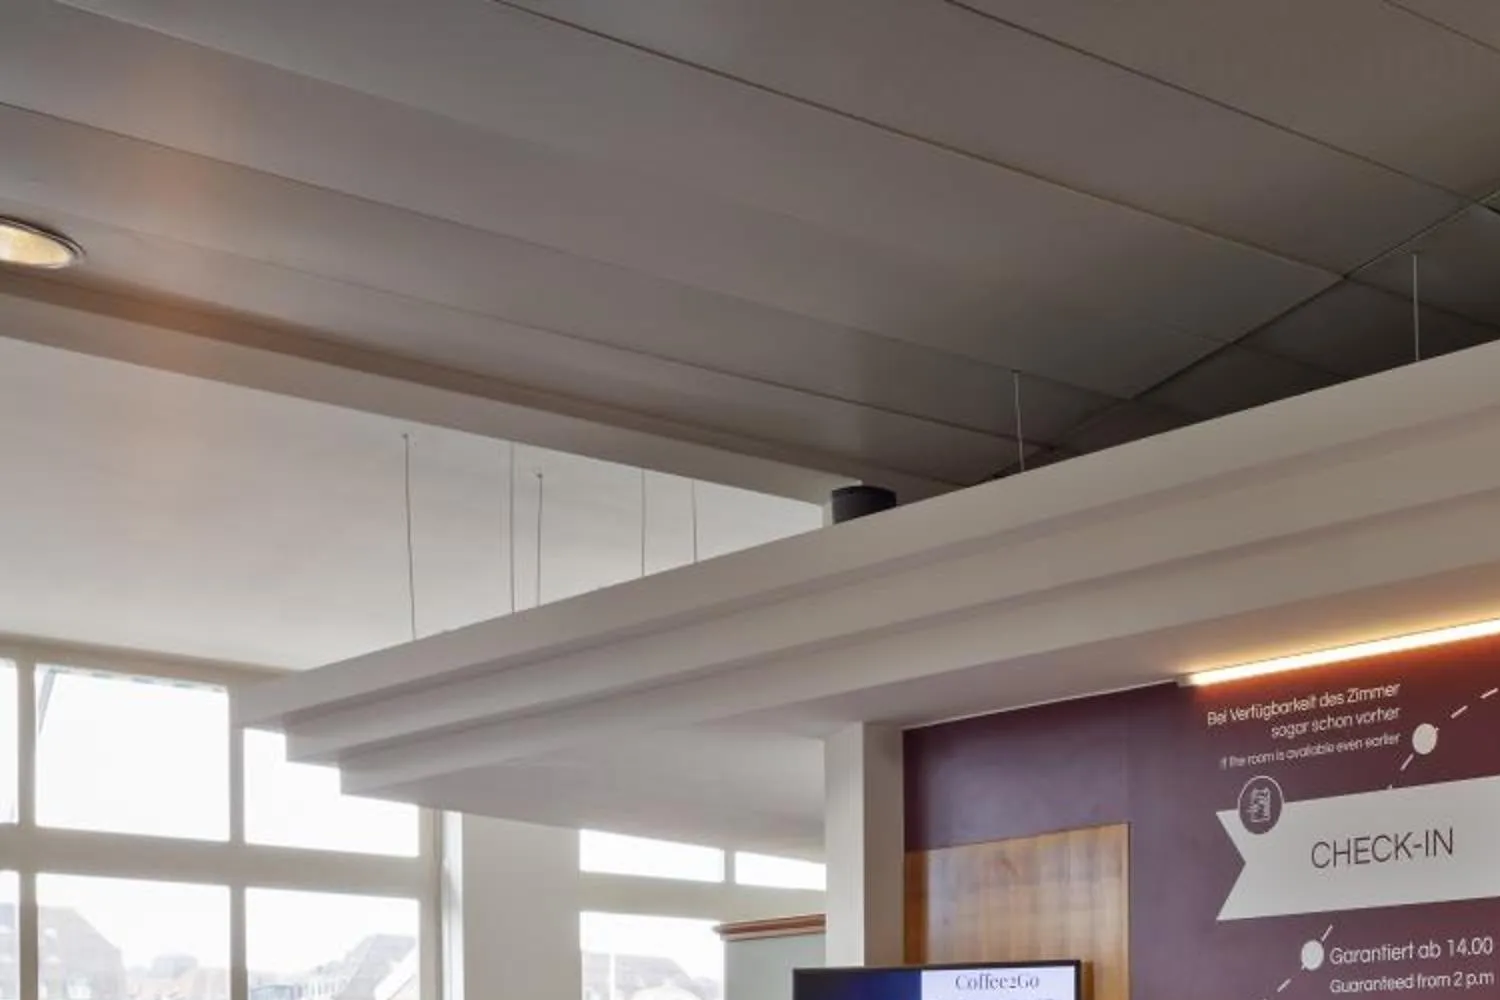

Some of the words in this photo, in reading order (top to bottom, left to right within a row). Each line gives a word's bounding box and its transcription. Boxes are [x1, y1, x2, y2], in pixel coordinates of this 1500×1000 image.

[1207, 711, 1228, 726] Bei
[1229, 696, 1318, 723] Verfügbarkeit
[1319, 691, 1345, 708] des
[1347, 683, 1401, 703] Zimmer
[1271, 721, 1310, 740] sogar
[1311, 713, 1354, 732] schon
[1355, 706, 1401, 726] vorher
[1247, 752, 1275, 766] room
[1276, 749, 1285, 762] is
[1286, 741, 1335, 760] available
[1336, 739, 1363, 753] even
[1365, 731, 1401, 747] earlier
[1310, 826, 1454, 869] CHECK-IN
[1329, 939, 1414, 965] Garantiert
[1416, 939, 1442, 960] ab
[1447, 935, 1494, 957] 14.00
[954, 973, 1041, 991] Coffee2Go
[1329, 973, 1415, 994] Guaranteed
[1416, 971, 1451, 989] from
[1452, 971, 1464, 988] 2
